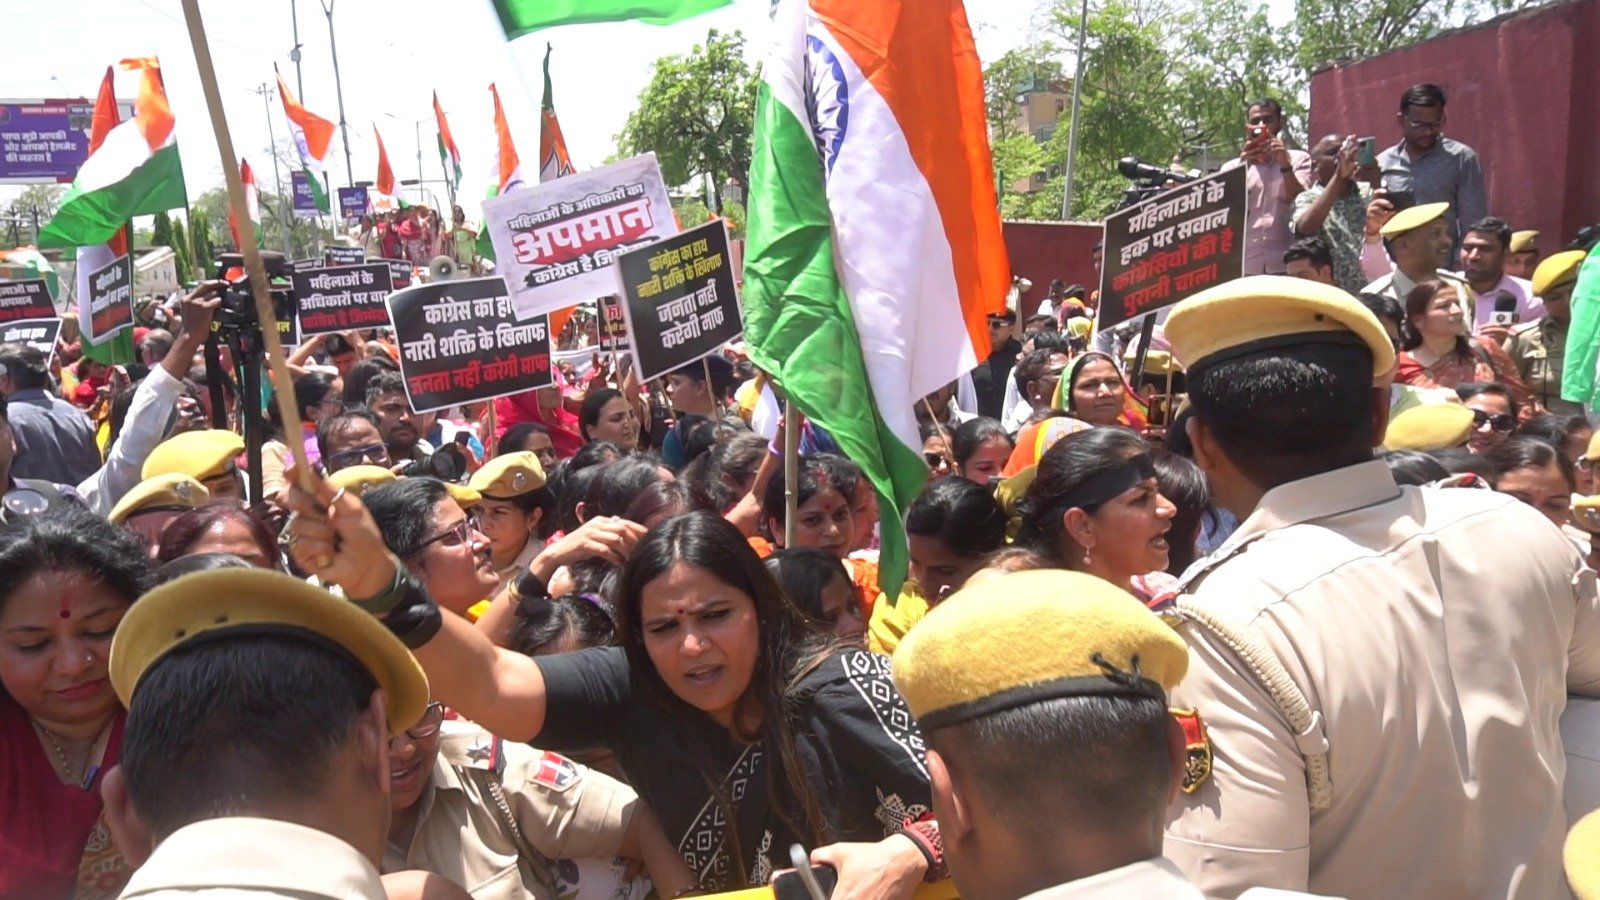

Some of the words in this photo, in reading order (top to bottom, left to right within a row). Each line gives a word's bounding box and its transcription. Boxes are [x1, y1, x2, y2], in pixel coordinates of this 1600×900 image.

[21, 141, 49, 151] आपको
[50, 141, 77, 151] हेलमेट
[39, 130, 67, 141] आपकी
[45, 151, 52, 163] है
[509, 205, 560, 229] महिलाओं
[560, 202, 575, 215] के
[576, 187, 626, 211] अधिकारों
[626, 183, 644, 196] का
[1128, 184, 1204, 234] महिलाओं
[1206, 180, 1225, 203] के
[513, 198, 653, 262] अपमान
[1120, 235, 1150, 266] हक
[1152, 226, 1175, 248] पर
[1177, 207, 1230, 240] सवाल
[1193, 233, 1218, 260] की
[1221, 227, 1234, 253] है
[533, 264, 579, 284] कांग्रेस
[581, 254, 593, 272] है
[648, 247, 681, 272] कांग्रेस
[680, 243, 693, 261] का
[693, 238, 708, 256] हाथ
[309, 271, 360, 290] महिलाओं
[361, 270, 374, 284] के
[636, 274, 661, 298] नारी
[663, 268, 685, 290] शक्ति
[685, 264, 695, 281] के
[694, 253, 723, 278] खिलाफ
[1123, 274, 1171, 317] पुरानी
[300, 290, 351, 310] अधिकारों
[352, 292, 368, 304] पर
[422, 296, 471, 324] कांग्रेस
[472, 298, 494, 319] का
[496, 296, 514, 317] हा
[656, 291, 697, 323] जनता
[696, 278, 718, 307] नहीं
[403, 333, 436, 362] नारी
[439, 329, 477, 357] शक्ति
[478, 326, 494, 350] के
[496, 322, 545, 348] खिलाफ
[660, 314, 701, 349] करेगी
[701, 305, 724, 331] माफ
[407, 371, 450, 396] जनता
[452, 360, 482, 388] नहीं
[482, 353, 518, 382] करेगी
[520, 353, 549, 374] माफ
